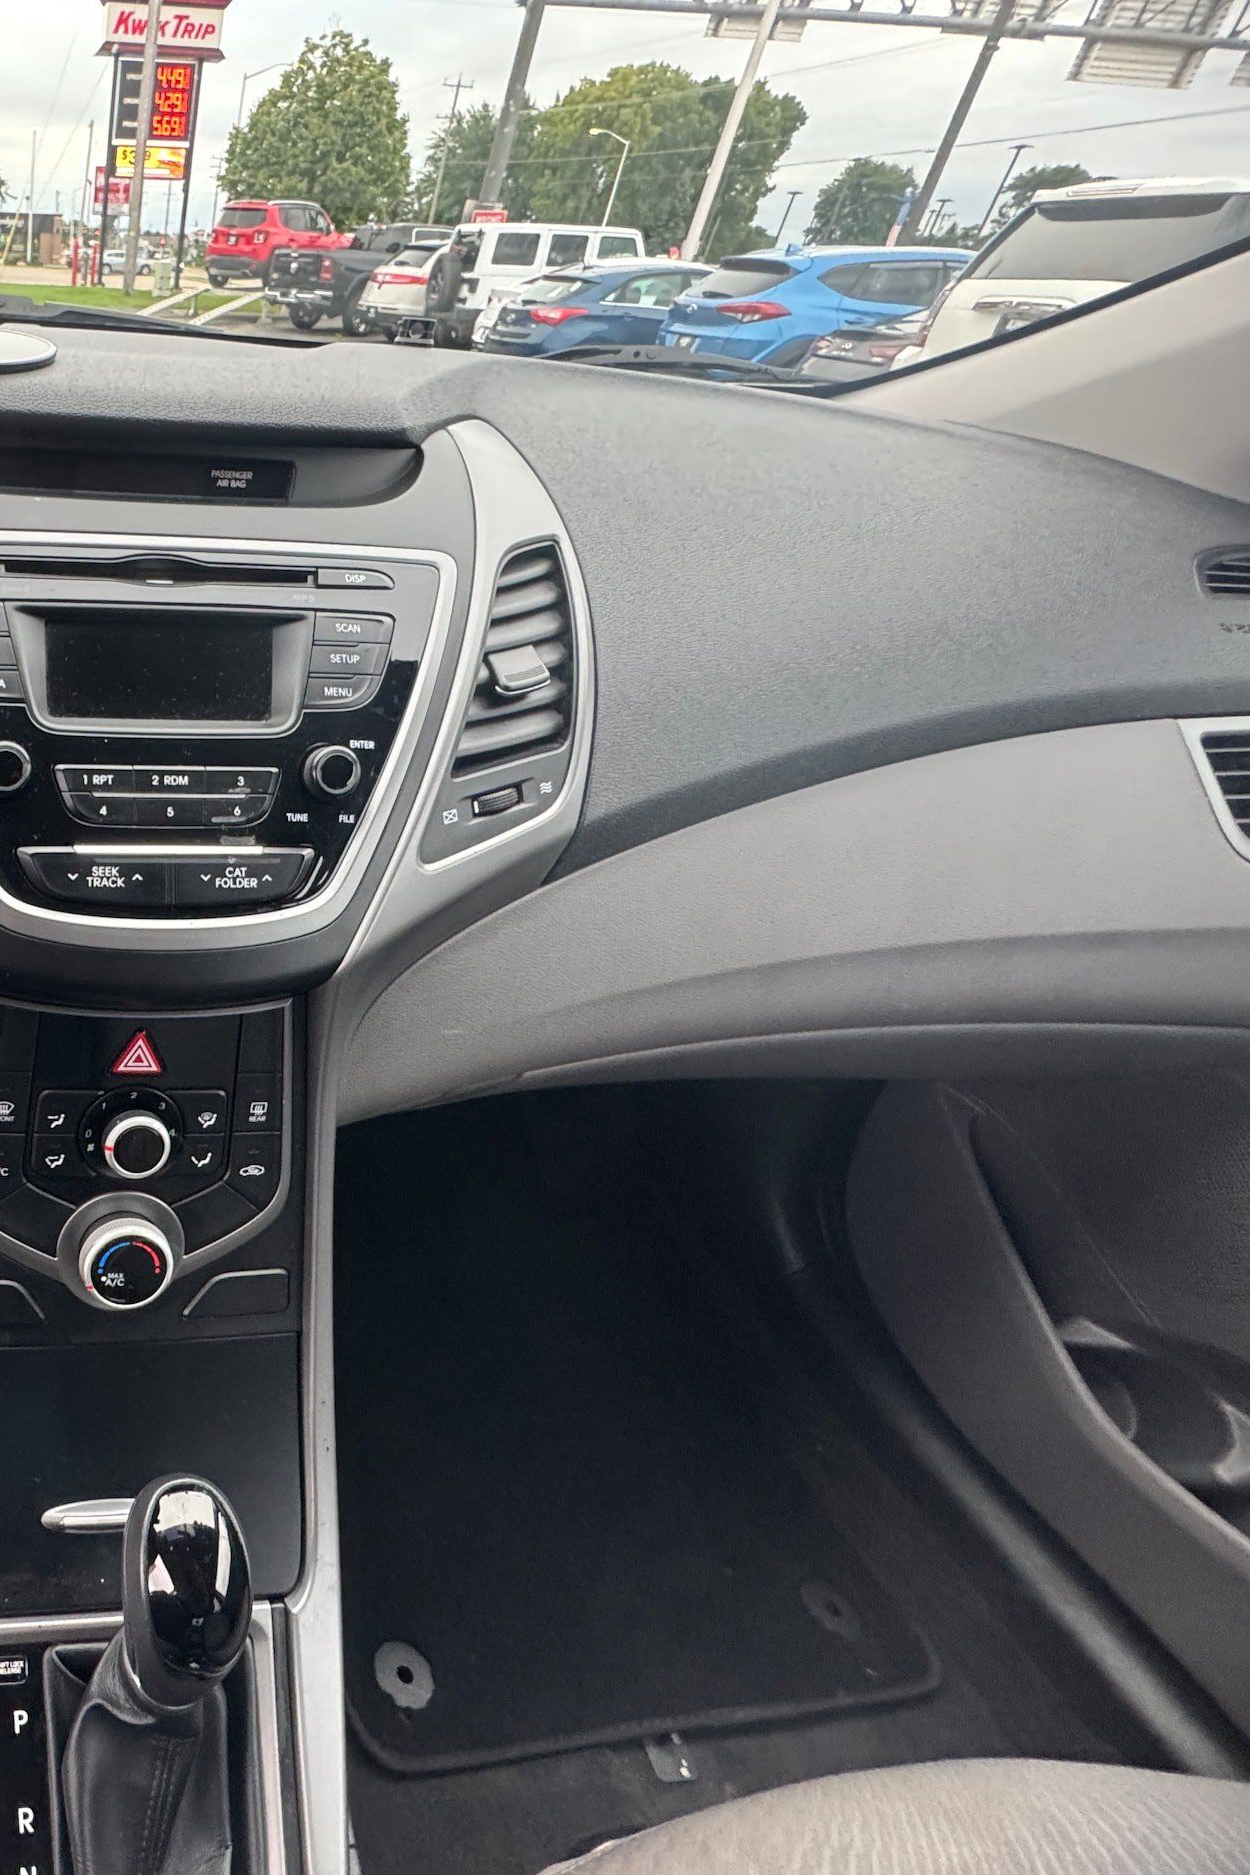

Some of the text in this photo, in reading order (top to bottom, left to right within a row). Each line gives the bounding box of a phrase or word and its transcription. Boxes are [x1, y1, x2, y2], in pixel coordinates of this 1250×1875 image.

[113, 11, 216, 40] KWK TRIP
[210, 470, 253, 480] PASSENGER
[217, 479, 246, 488] AIR BAG
[345, 574, 366, 584] DISP
[335, 623, 361, 634] SCAN
[330, 653, 360, 664] SETUP
[324, 687, 352, 697] MENU
[350, 740, 375, 750] ENTER
[83, 774, 114, 785] 1 RPT
[152, 775, 188, 786] 2 RDM
[238, 776, 245, 786] 3
[100, 805, 107, 815] 4
[167, 807, 174, 817] 5
[234, 805, 241, 816] 6
[287, 813, 308, 823] TUNE
[339, 814, 354, 824] FILE
[92, 866, 119, 877] SEEK
[226, 868, 247, 878] CAT
[86, 876, 125, 888] TRACK
[215, 877, 258, 889] FOLDER
[130, 1091, 138, 1099] 2
[101, 1102, 107, 1110] 1
[158, 1102, 166, 1110] 3
[249, 1114, 266, 1122] REAR
[169, 1128, 176, 1137] 4
[105, 1278, 125, 1287] A/C
[13, 1710, 28, 1734] P
[17, 1807, 35, 1834] R
